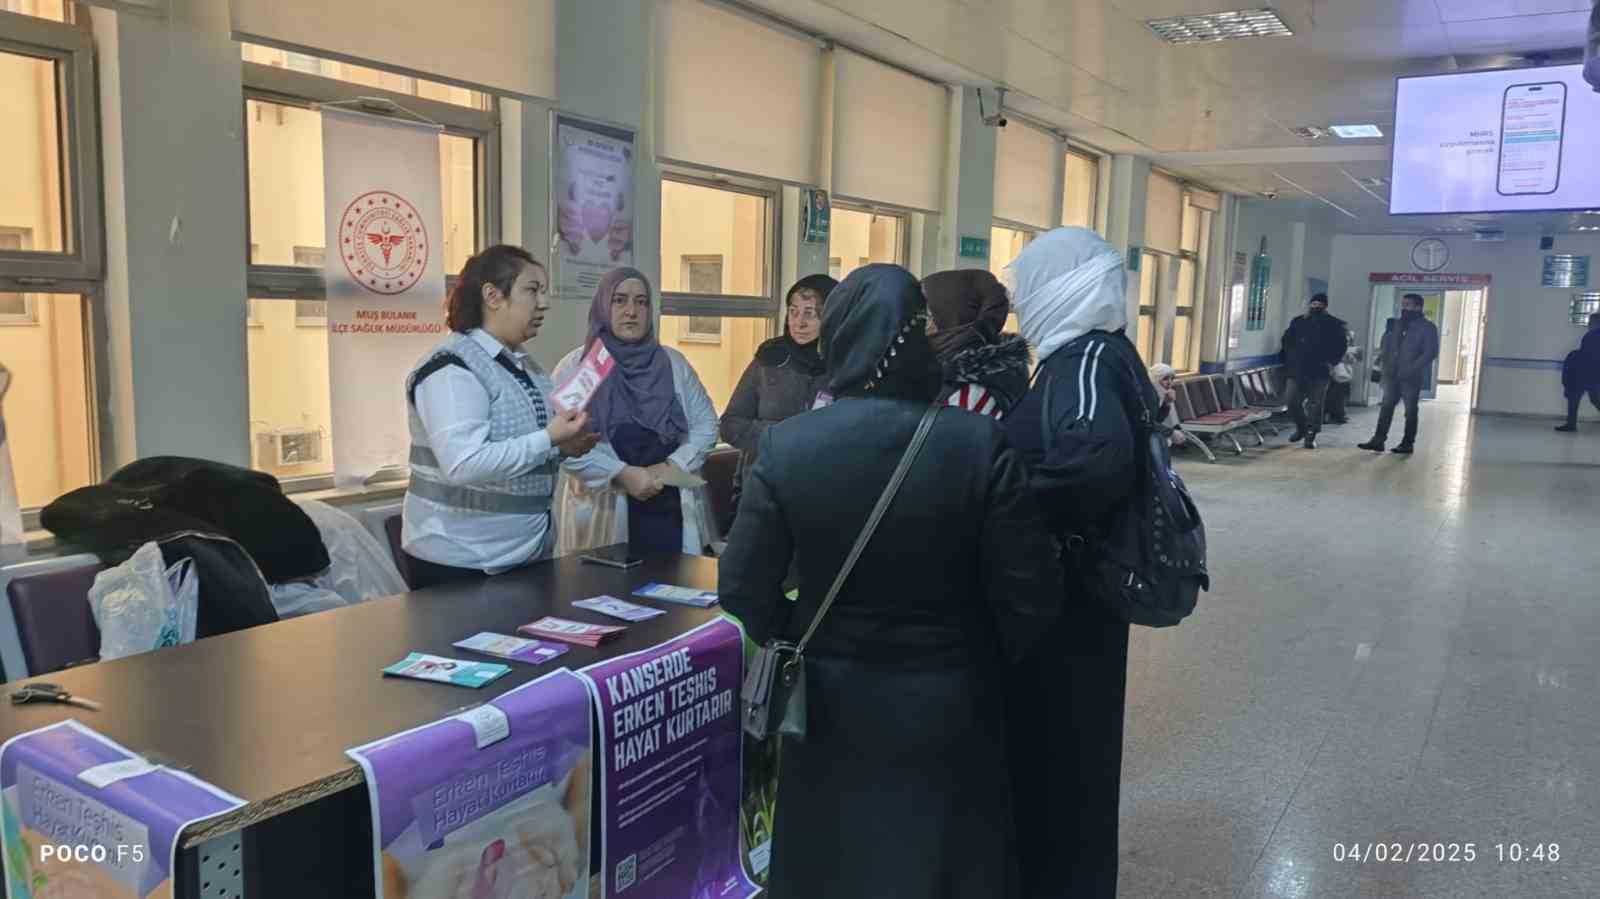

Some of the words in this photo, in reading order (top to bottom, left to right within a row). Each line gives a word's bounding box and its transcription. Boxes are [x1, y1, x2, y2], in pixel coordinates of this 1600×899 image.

[350, 322, 384, 333] SAĞLIK
[356, 310, 379, 321] MUŞ
[381, 311, 417, 320] BULANIK
[606, 648, 693, 705] KANSERDE
[613, 691, 665, 739] ERKEN
[614, 724, 662, 772] HAYAT
[666, 689, 733, 745] KURTARIR
[432, 774, 489, 809] Erken
[433, 793, 486, 832] Hayat
